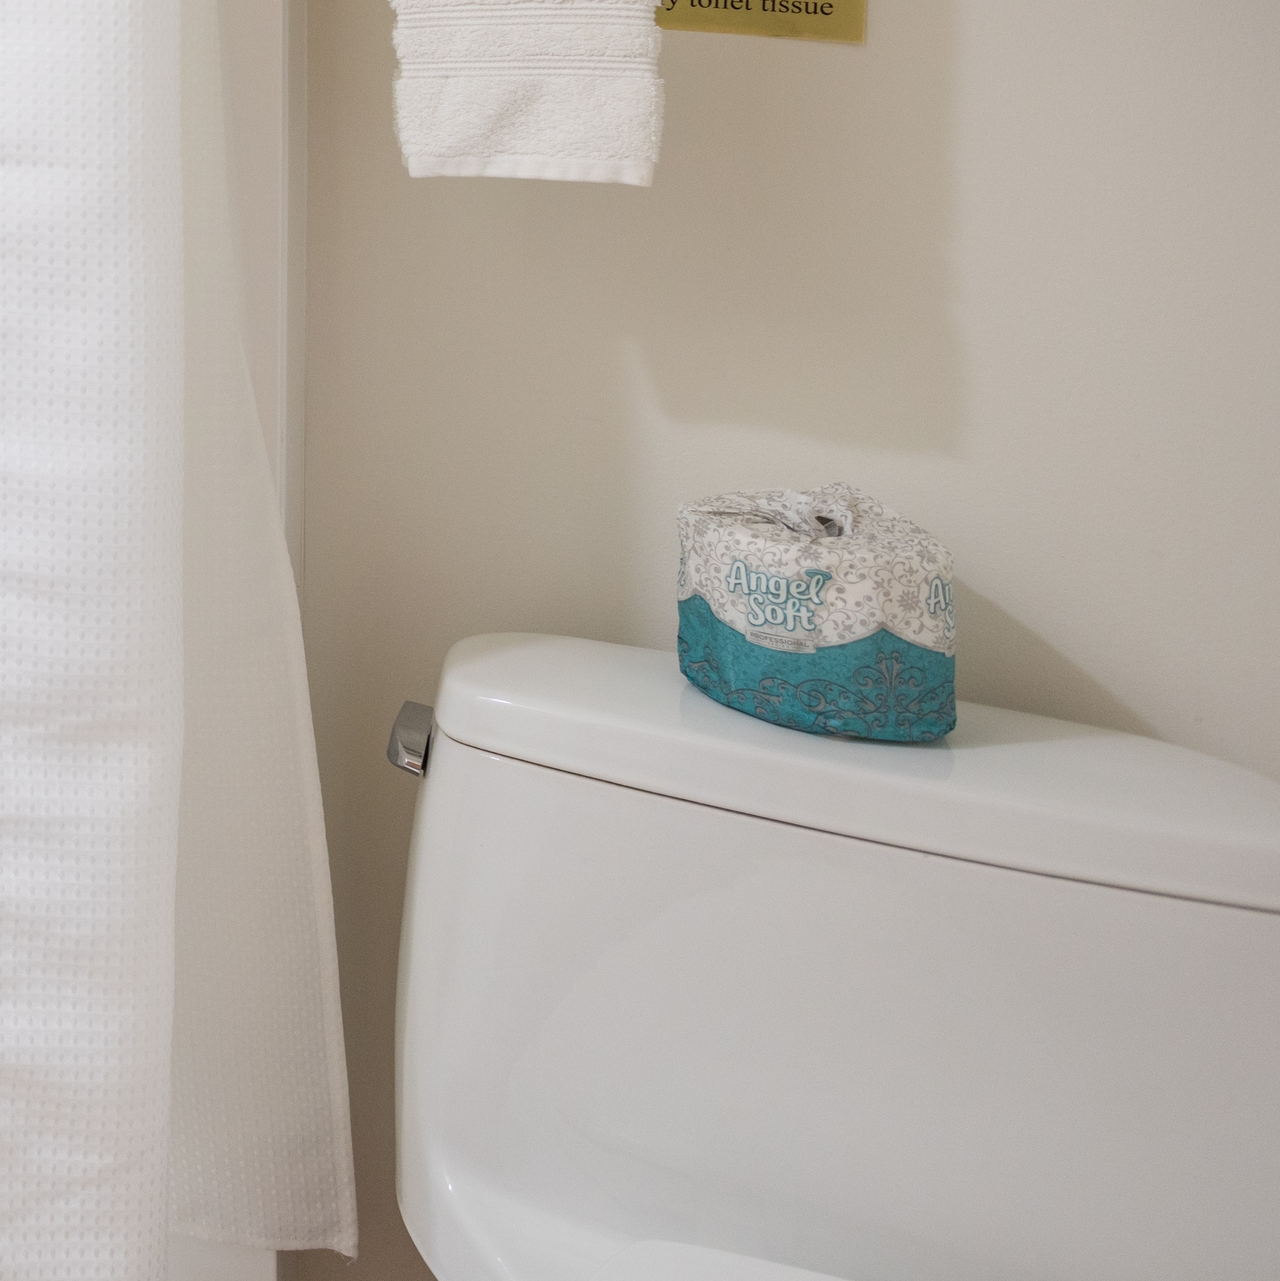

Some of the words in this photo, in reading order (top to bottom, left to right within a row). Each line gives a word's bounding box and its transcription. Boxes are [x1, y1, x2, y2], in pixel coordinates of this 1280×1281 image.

[726, 560, 825, 605] Angel
[747, 593, 817, 632] Soft
[749, 631, 810, 648] PROFESSIONAL
